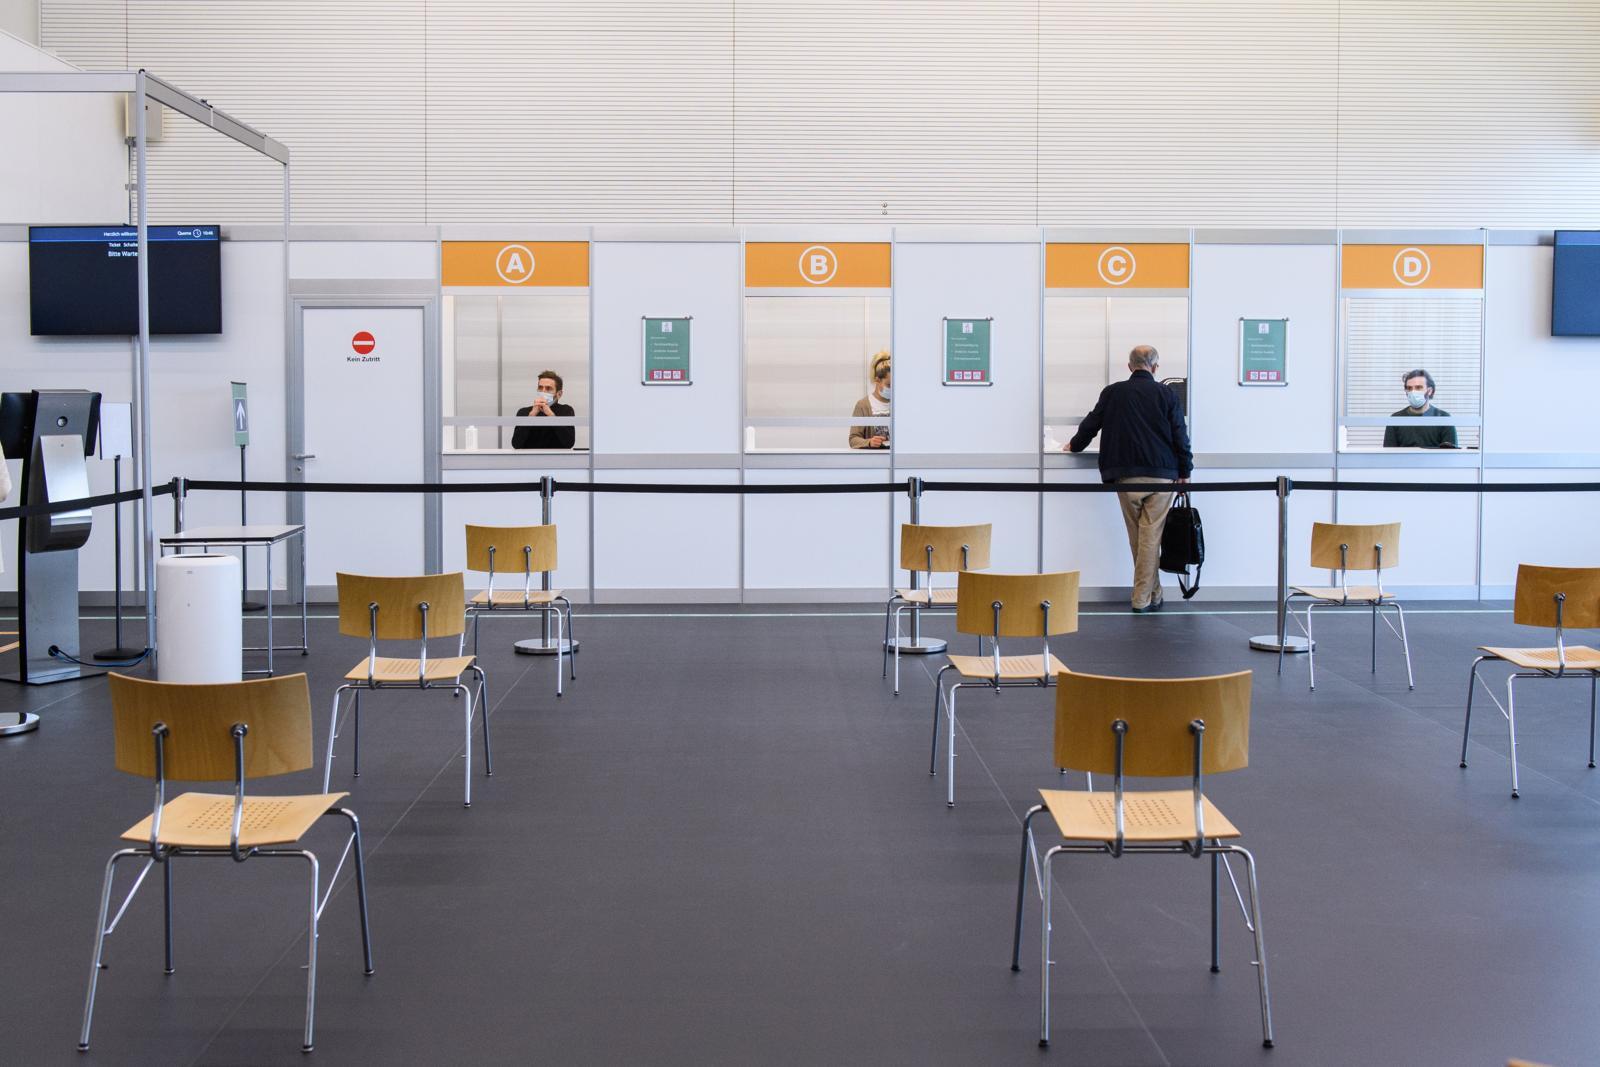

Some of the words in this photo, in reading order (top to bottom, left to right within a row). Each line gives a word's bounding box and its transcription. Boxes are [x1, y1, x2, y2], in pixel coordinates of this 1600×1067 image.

[505, 252, 525, 273] A
[811, 254, 828, 275] B
[1108, 255, 1127, 276] C
[1403, 256, 1422, 277] D
